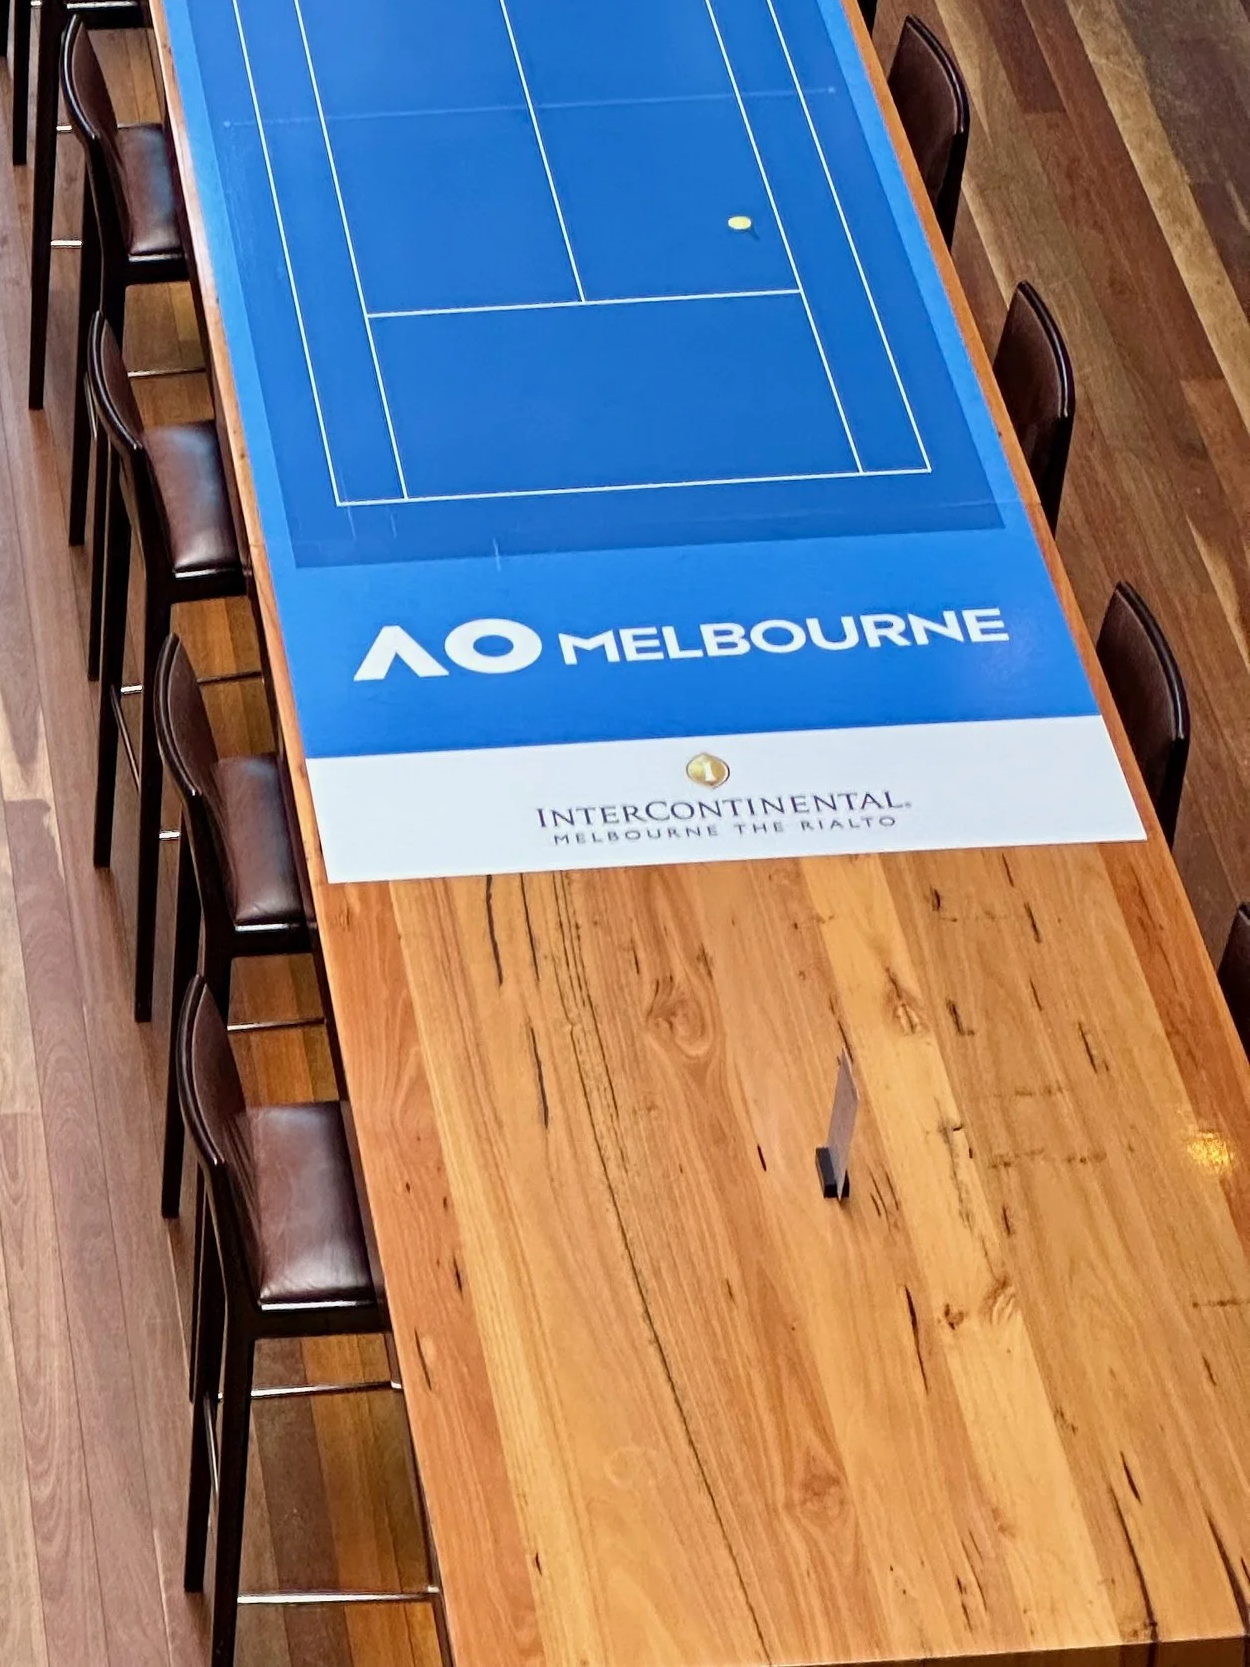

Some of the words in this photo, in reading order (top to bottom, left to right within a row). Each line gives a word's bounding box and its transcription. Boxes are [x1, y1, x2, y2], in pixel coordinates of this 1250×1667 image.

[353, 618, 543, 681] AO
[560, 608, 1010, 665] MELBOURNE
[553, 824, 720, 846] MELBOURNE
[735, 820, 785, 835] THE
[801, 815, 897, 832] RIALTO
